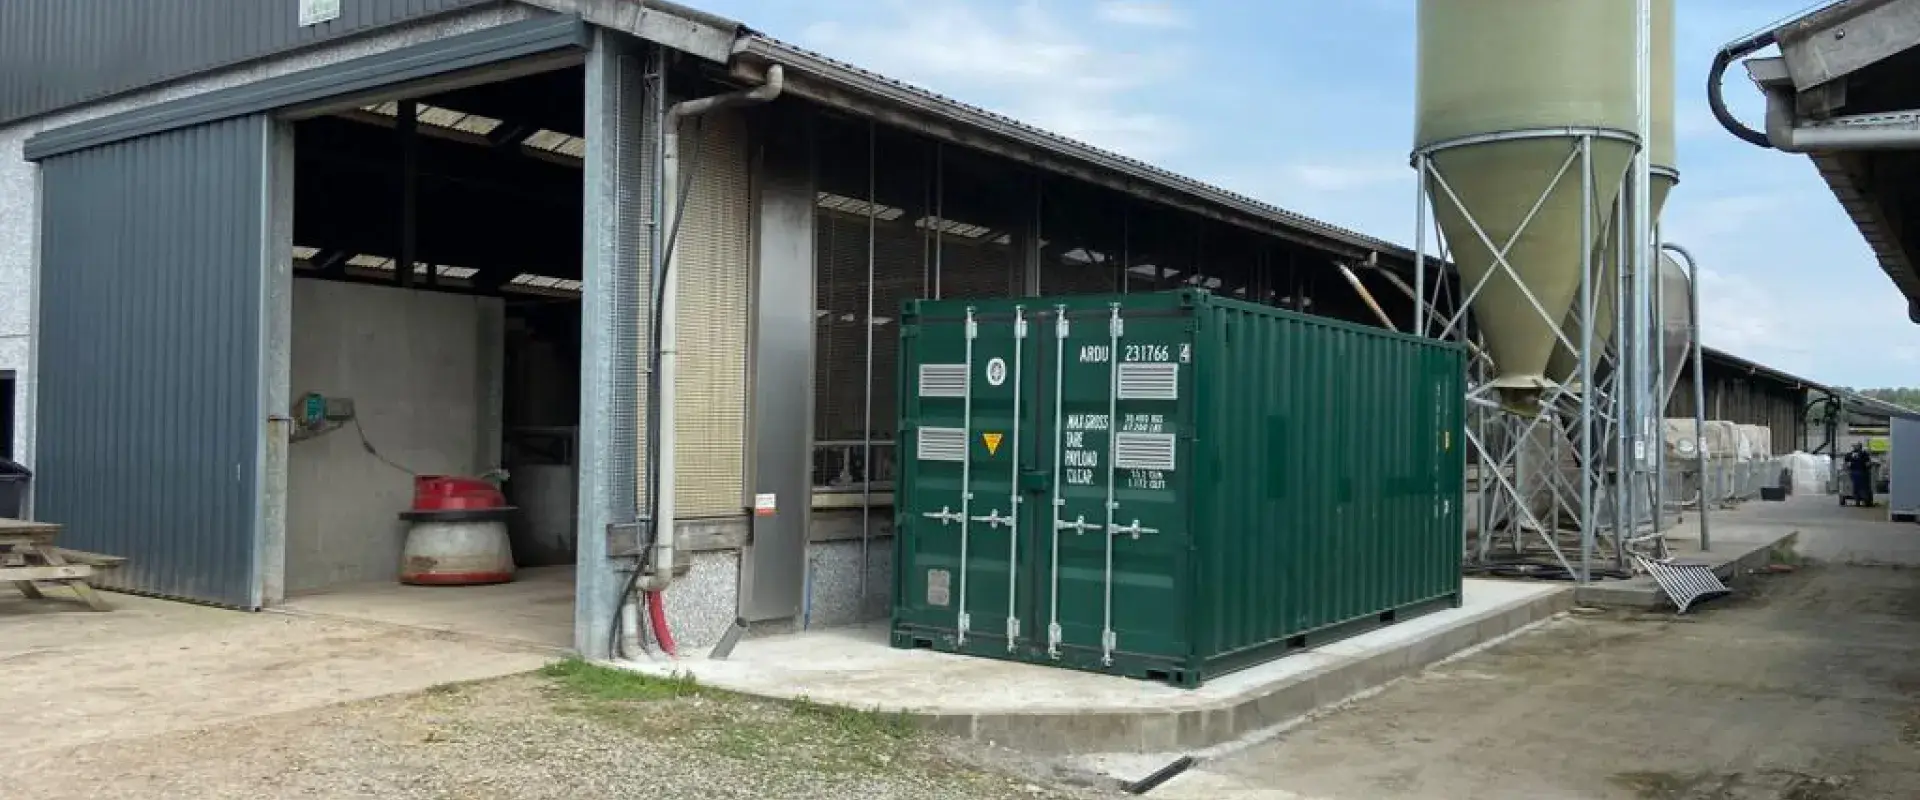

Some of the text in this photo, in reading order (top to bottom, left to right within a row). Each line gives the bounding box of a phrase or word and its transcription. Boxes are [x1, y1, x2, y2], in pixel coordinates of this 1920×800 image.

[1080, 344, 1191, 362] ARDU 231766 4
[1066, 431, 1083, 448] TARE
[1064, 450, 1098, 467] PAYLOAD
